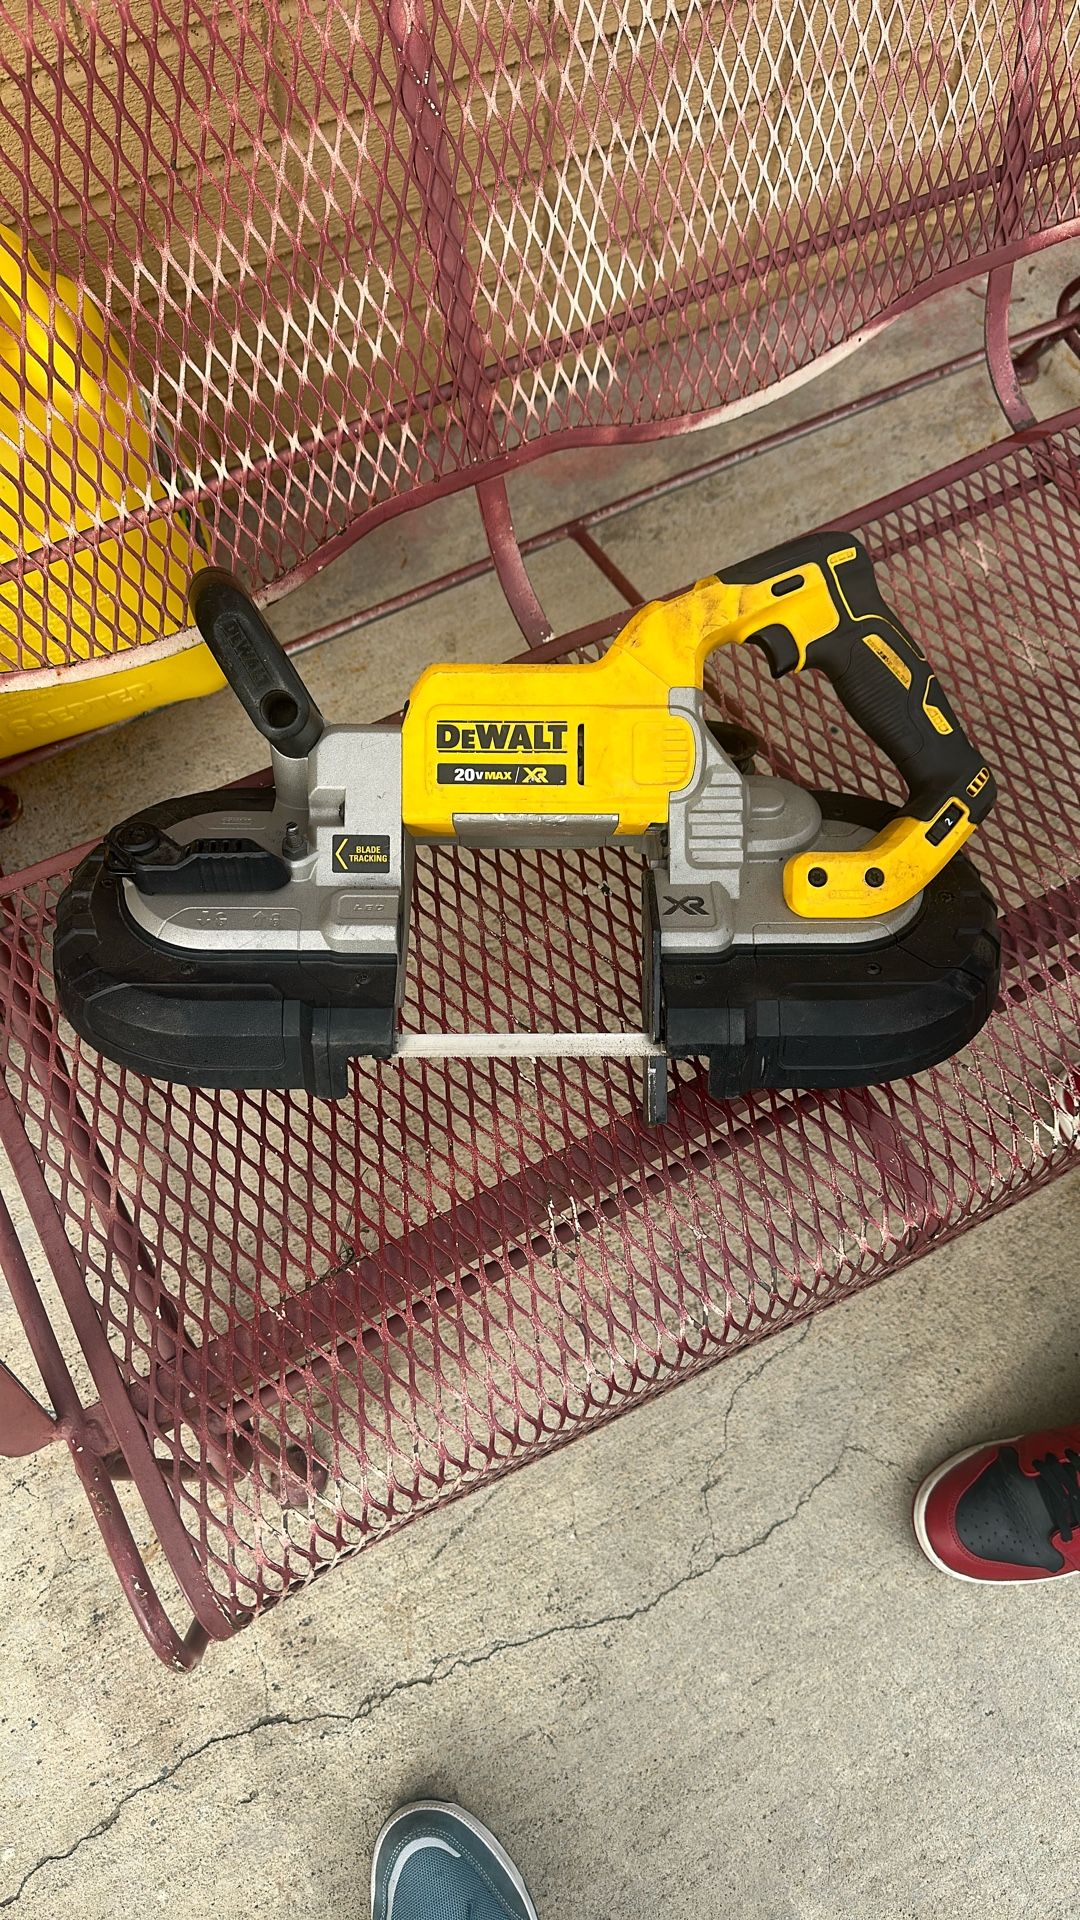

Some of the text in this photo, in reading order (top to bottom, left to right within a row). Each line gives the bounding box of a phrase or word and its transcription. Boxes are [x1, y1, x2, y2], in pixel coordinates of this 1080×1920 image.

[9, 680, 153, 736] SCEPTER
[485, 771, 512, 781] MAX
[522, 767, 549, 783] XR
[944, 817, 954, 827] 2
[355, 845, 381, 854] BLADE
[349, 854, 388, 863] TRACKING
[662, 895, 710, 916] XR
